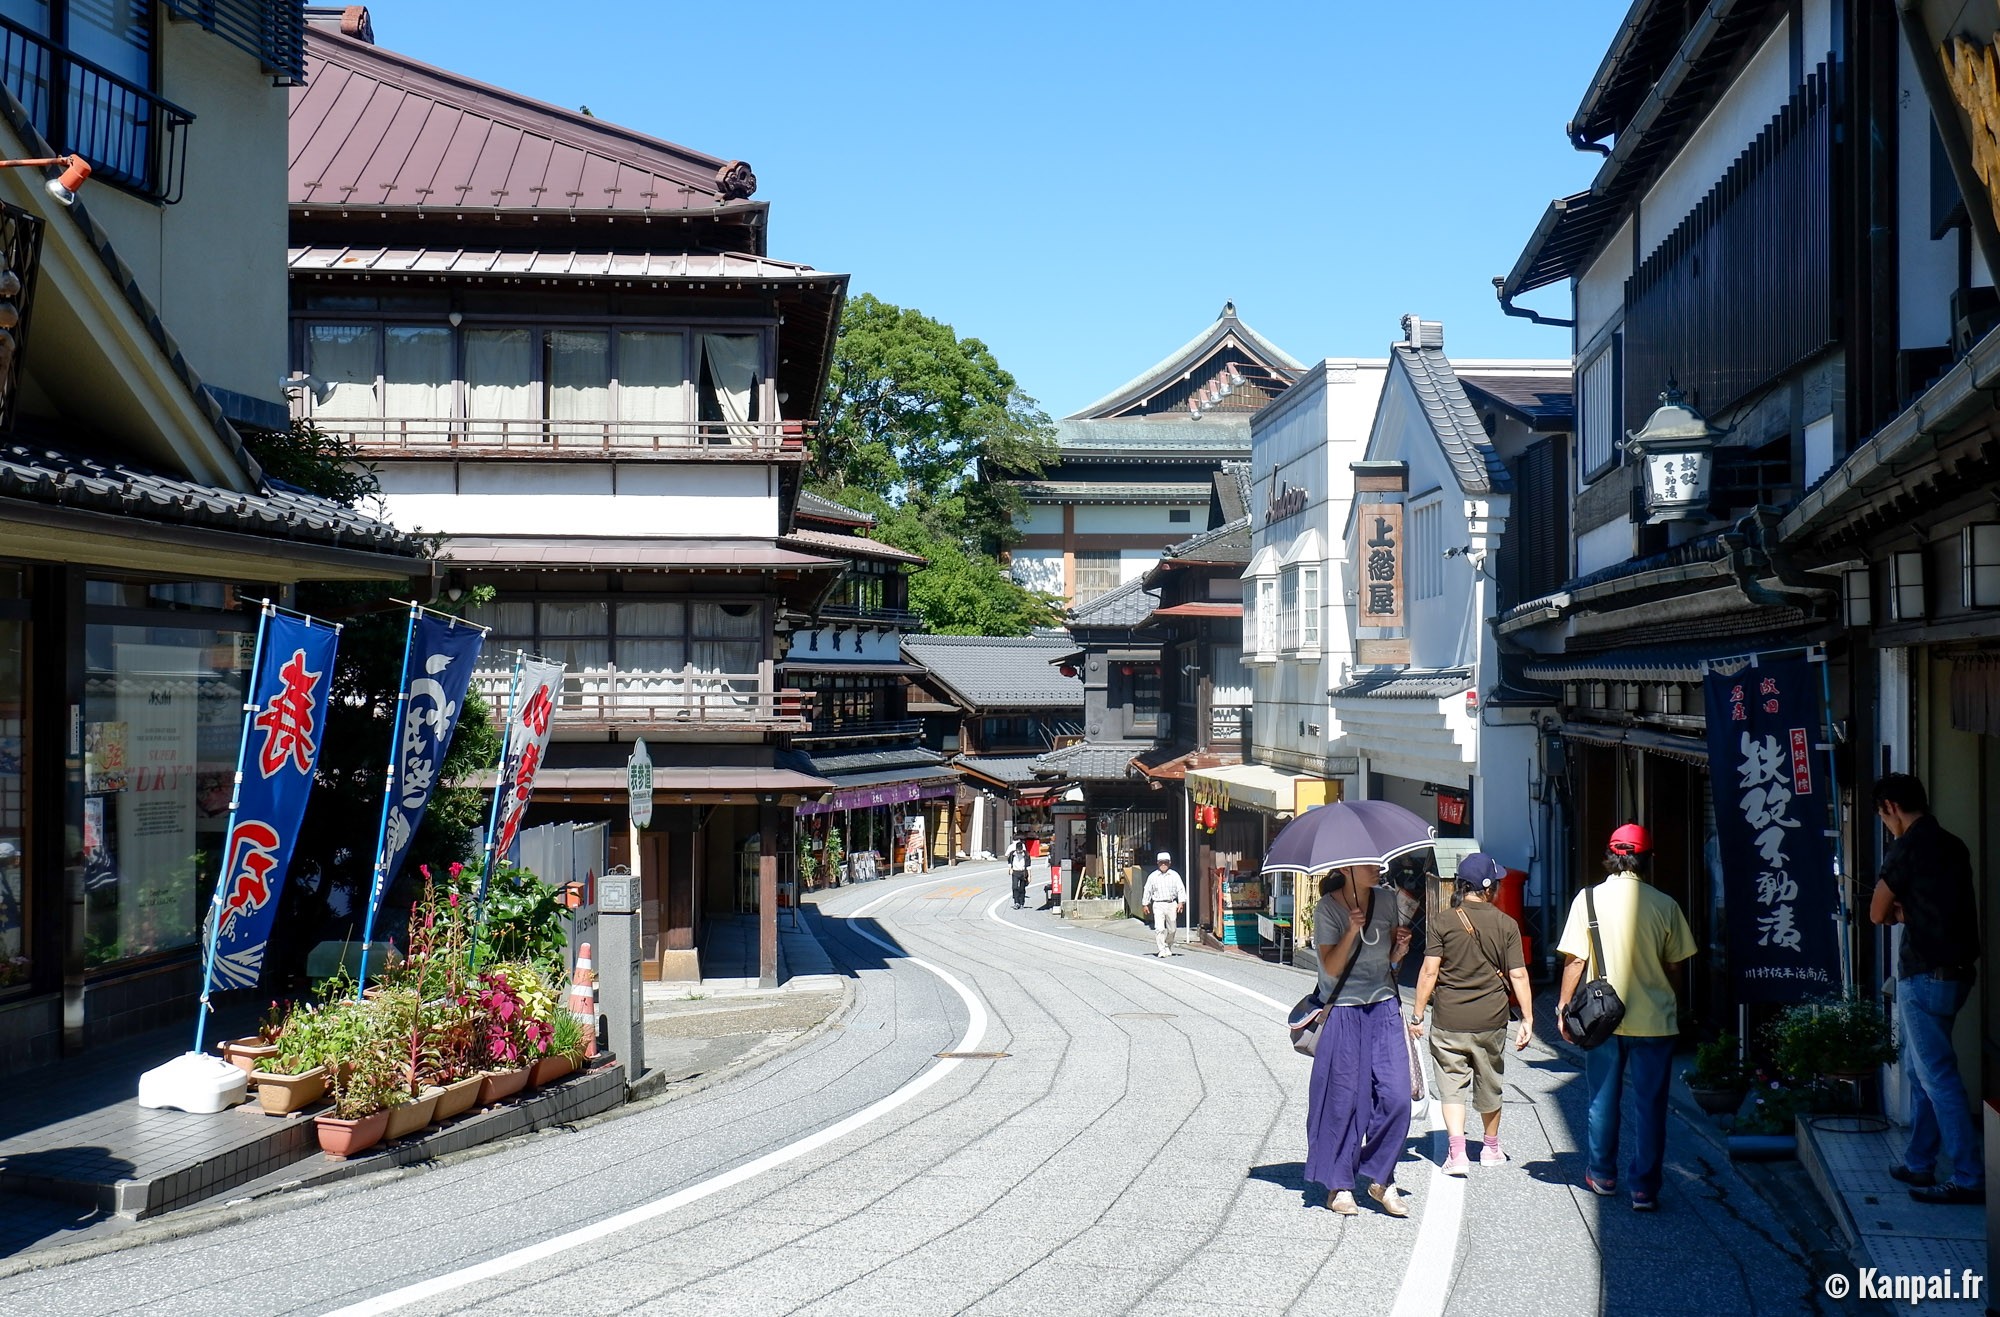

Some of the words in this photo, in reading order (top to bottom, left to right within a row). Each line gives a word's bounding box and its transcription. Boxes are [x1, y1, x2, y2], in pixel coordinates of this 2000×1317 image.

[630, 763, 651, 791] 表参道
[1745, 966, 1828, 982] 川村佐平治商店
